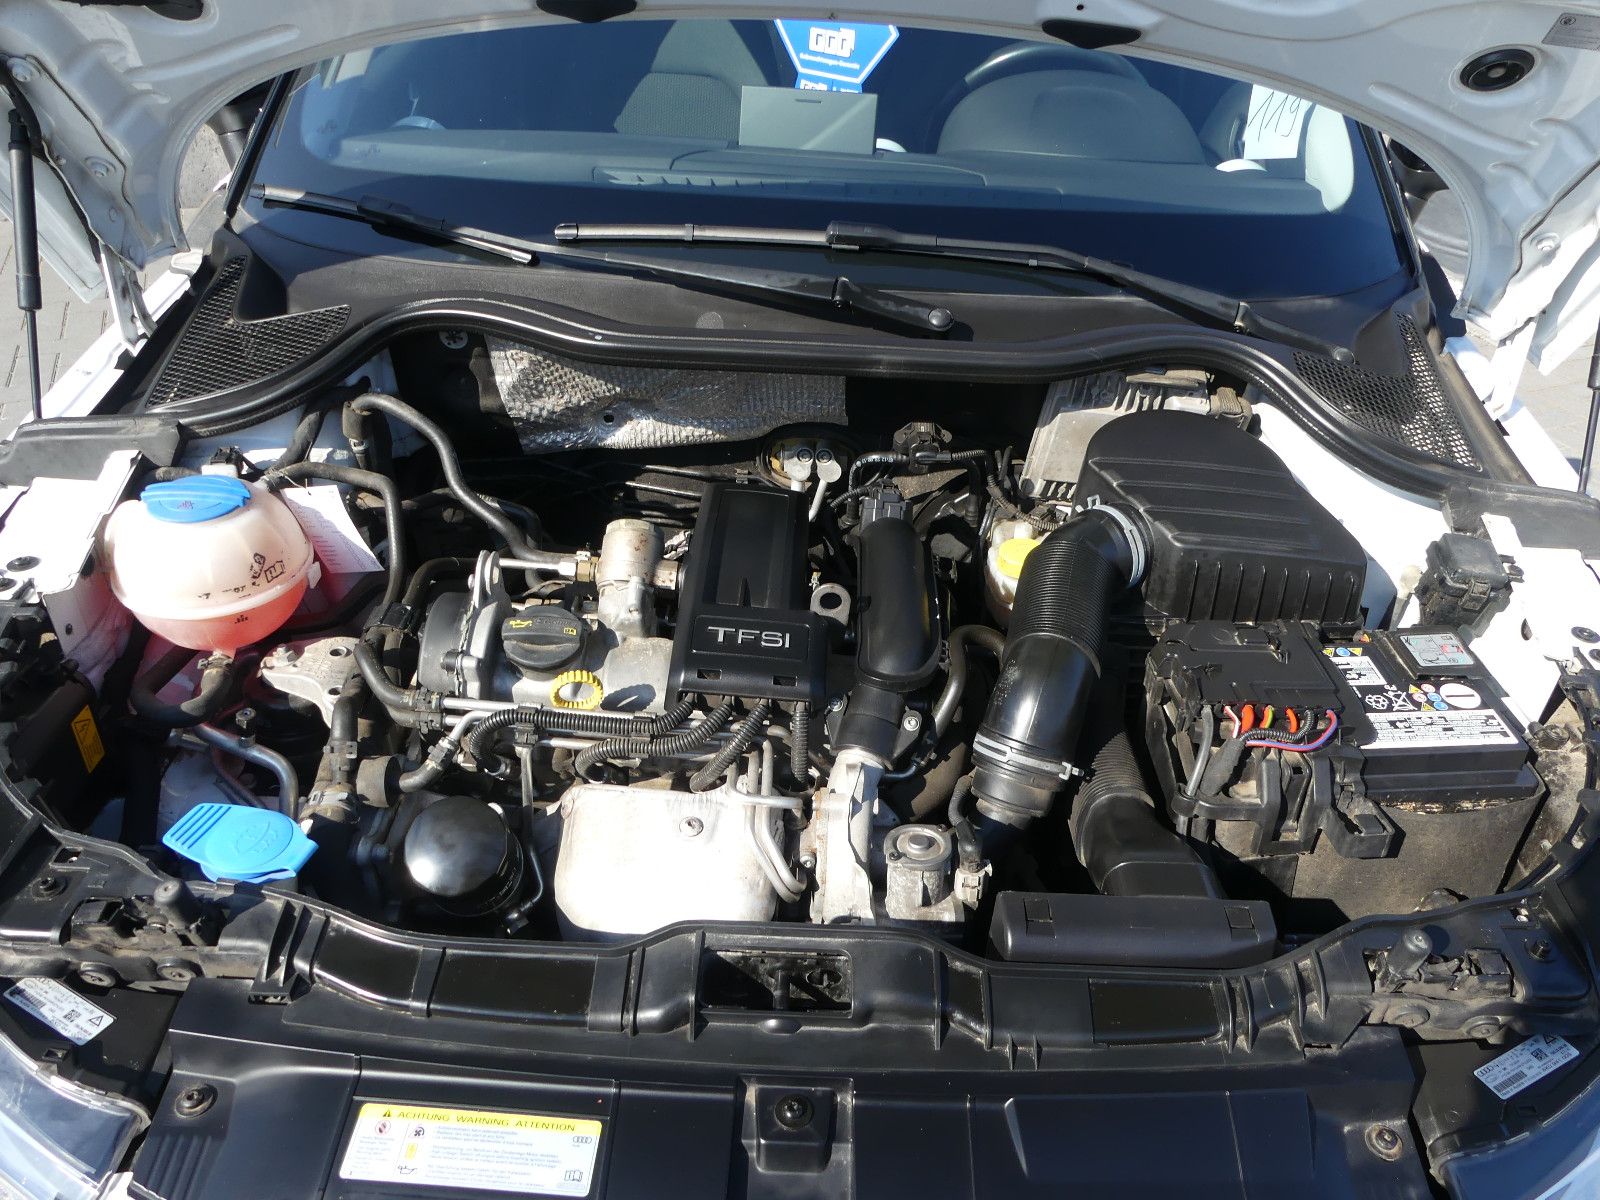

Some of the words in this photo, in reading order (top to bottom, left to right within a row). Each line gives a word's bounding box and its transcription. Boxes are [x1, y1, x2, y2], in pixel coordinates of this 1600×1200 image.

[1247, 90, 1302, 143] 119
[708, 626, 790, 649] TFSI
[397, 1111, 450, 1122] ACHTUNG
[456, 1115, 509, 1127] WARNING
[515, 1120, 577, 1132] ATTENTION
